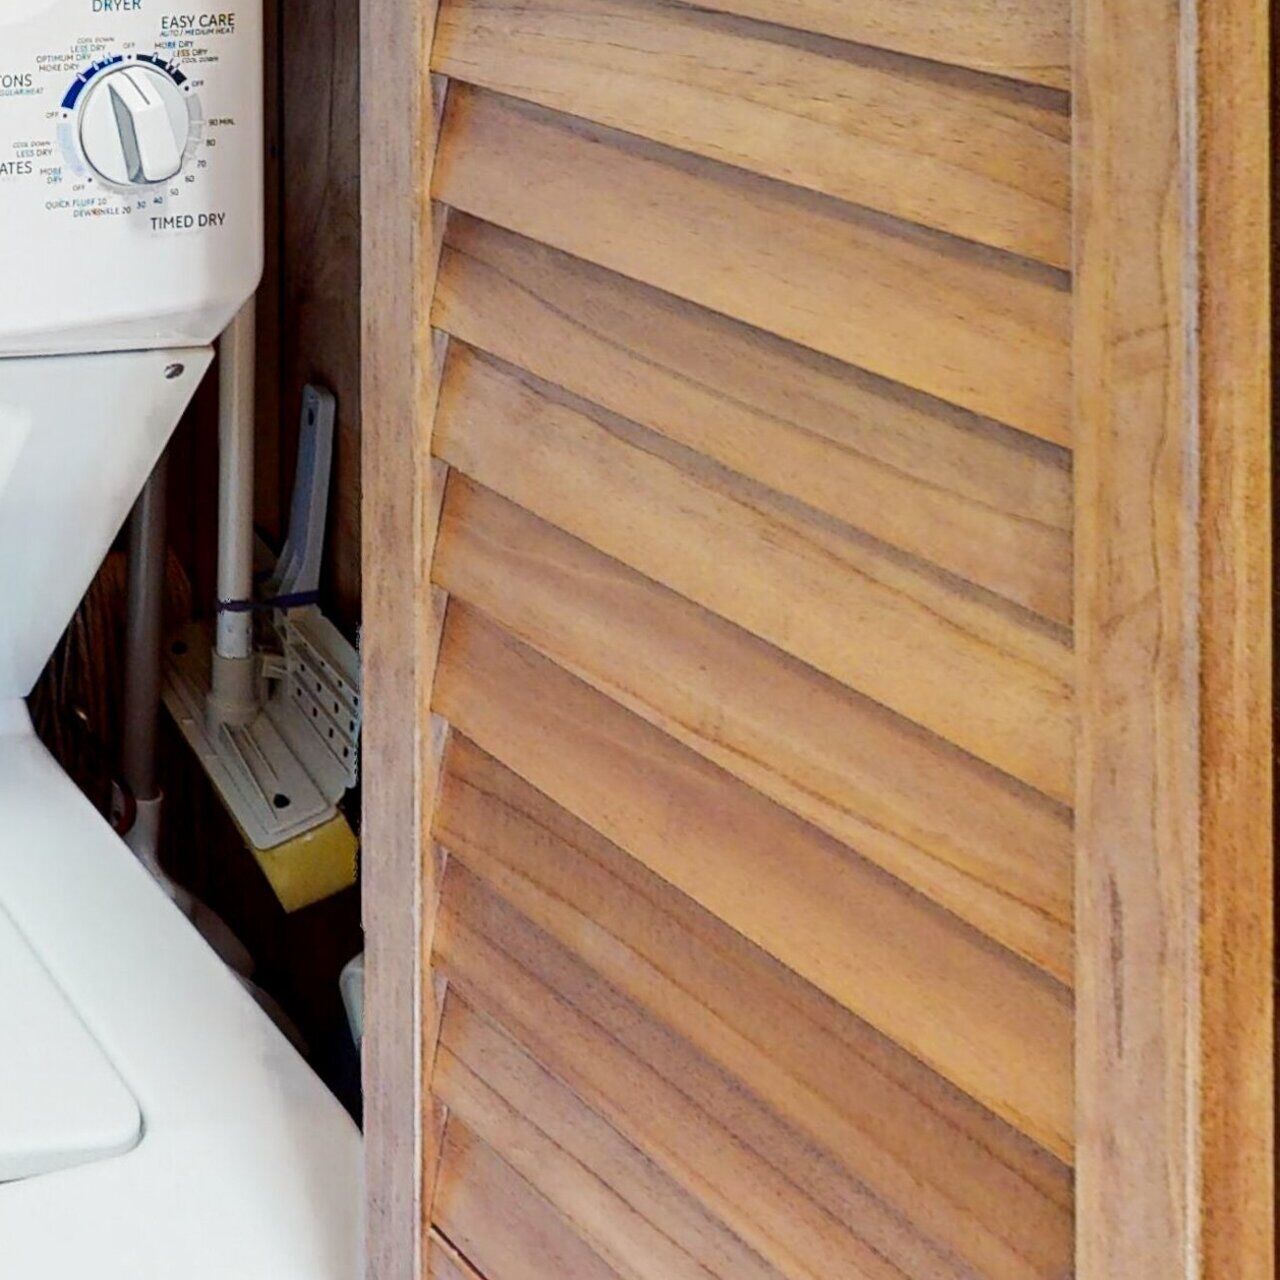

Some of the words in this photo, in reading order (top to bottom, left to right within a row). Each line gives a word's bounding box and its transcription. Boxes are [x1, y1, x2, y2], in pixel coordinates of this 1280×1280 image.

[161, 14, 196, 30] EASY
[198, 12, 236, 28] CARE
[70, 45, 89, 54] LESS
[89, 43, 107, 52] DRY
[154, 41, 177, 50] MORE
[178, 40, 194, 49] DRY
[35, 54, 74, 64] OPTIMUM
[75, 52, 92, 62] DRY
[172, 49, 191, 58] LESS
[191, 48, 208, 57] DRY
[38, 64, 62, 73] MORE
[63, 63, 80, 72] DRY
[190, 79, 204, 88] OFF
[208, 118, 218, 127] 90
[206, 138, 216, 147] 80
[16, 149, 35, 158] LESS
[36, 148, 54, 158] DRY
[39, 167, 62, 176] MORE
[46, 176, 63, 185] DRY
[44, 200, 71, 211] QUICK
[71, 198, 96, 208] FLUFF
[150, 215, 194, 231] TIMED
[198, 212, 226, 228] DRY
